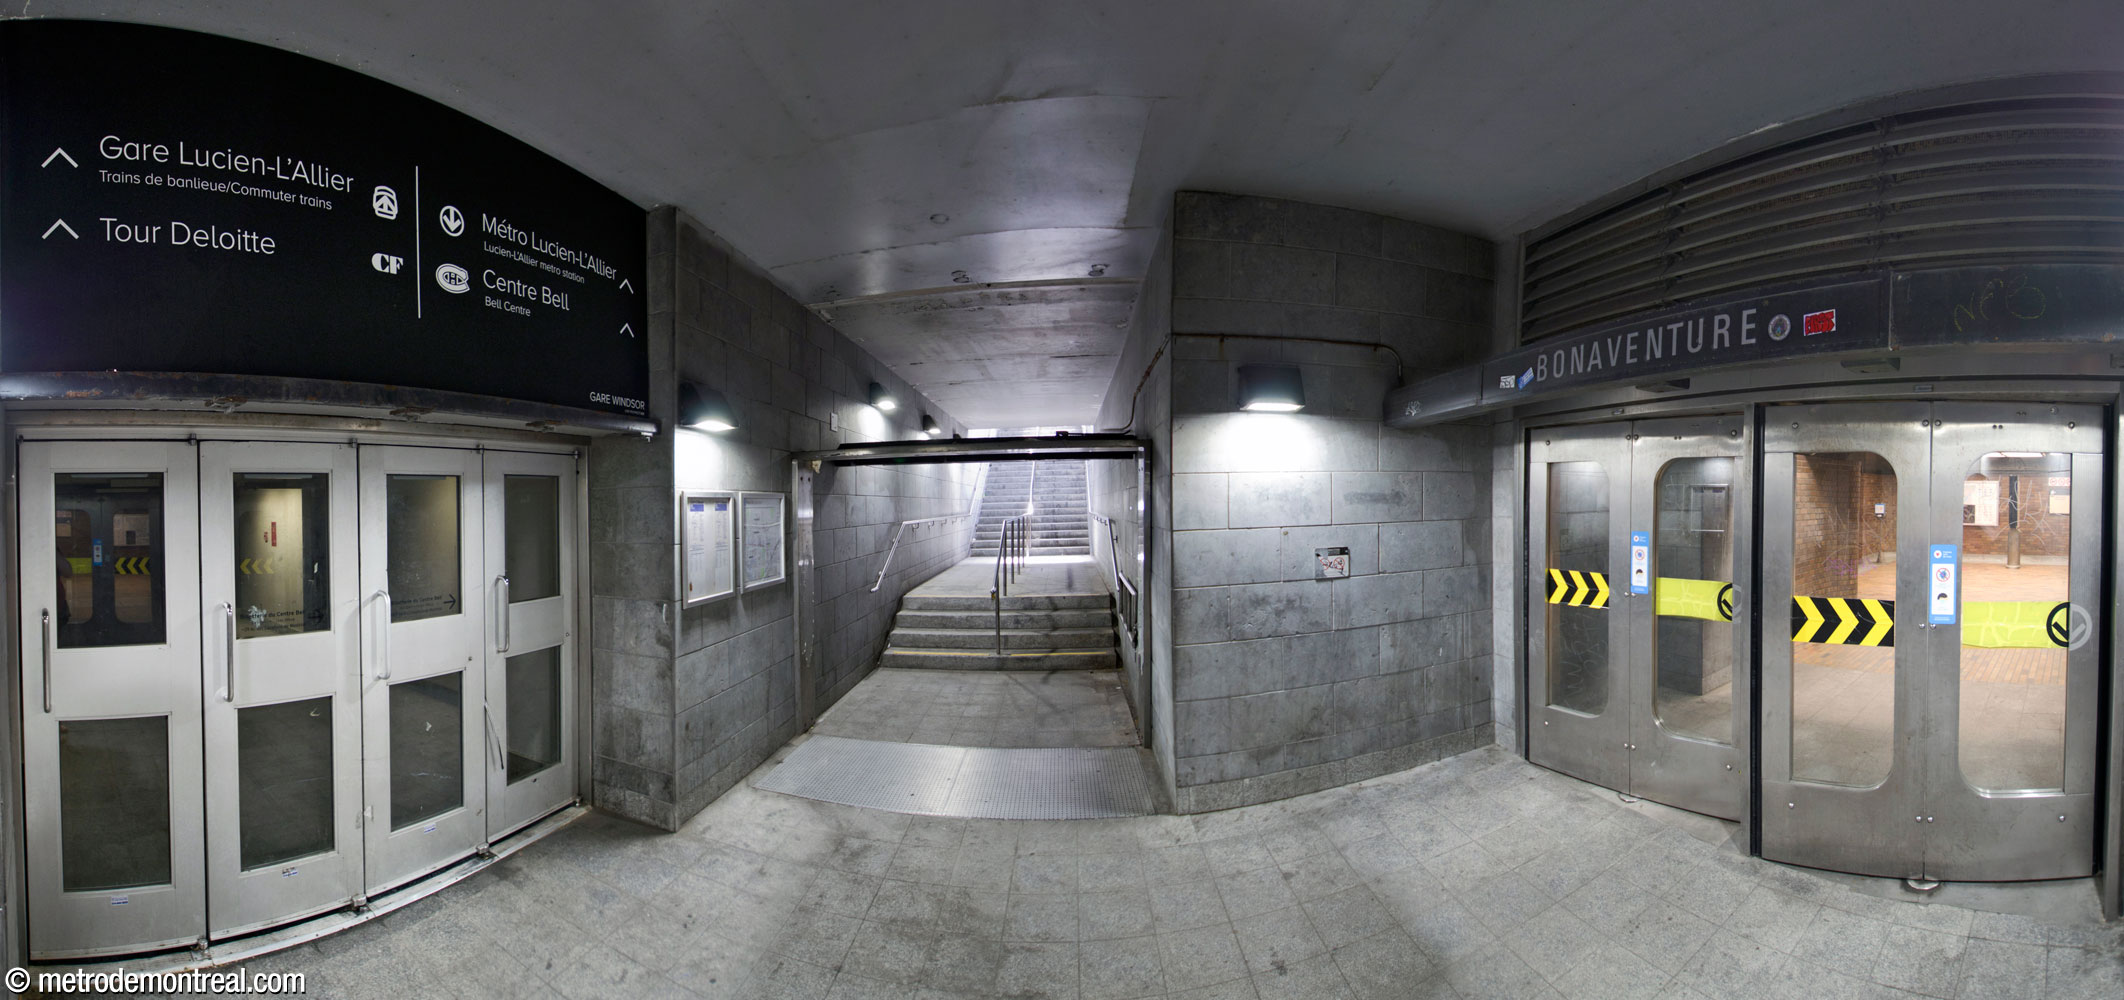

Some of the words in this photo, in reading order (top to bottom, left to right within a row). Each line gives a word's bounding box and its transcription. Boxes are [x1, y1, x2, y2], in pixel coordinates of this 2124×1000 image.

[99, 135, 169, 163] Gare
[179, 141, 354, 193] Lucien-L’Allier
[99, 170, 141, 184] Trains
[144, 173, 163, 186] de
[167, 174, 297, 204] banlieue/Commuter
[299, 194, 333, 210] trains
[99, 217, 161, 244] Tour
[171, 221, 276, 255] Deloitte
[482, 213, 528, 246] Métro
[531, 231, 617, 281] Lucien-L’Allier
[371, 252, 404, 275] CF
[483, 241, 539, 268] Lucien-L’Allier
[539, 260, 562, 276] metro
[562, 268, 586, 284] station
[482, 269, 538, 301] Centre
[541, 286, 570, 311] Bell
[485, 296, 503, 310] Bell
[503, 301, 532, 317] Centre
[1536, 308, 1757, 382] BONAVENTURE
[589, 391, 611, 405] GARE
[611, 395, 646, 410] WINDSOR
[276, 609, 294, 617] Centre
